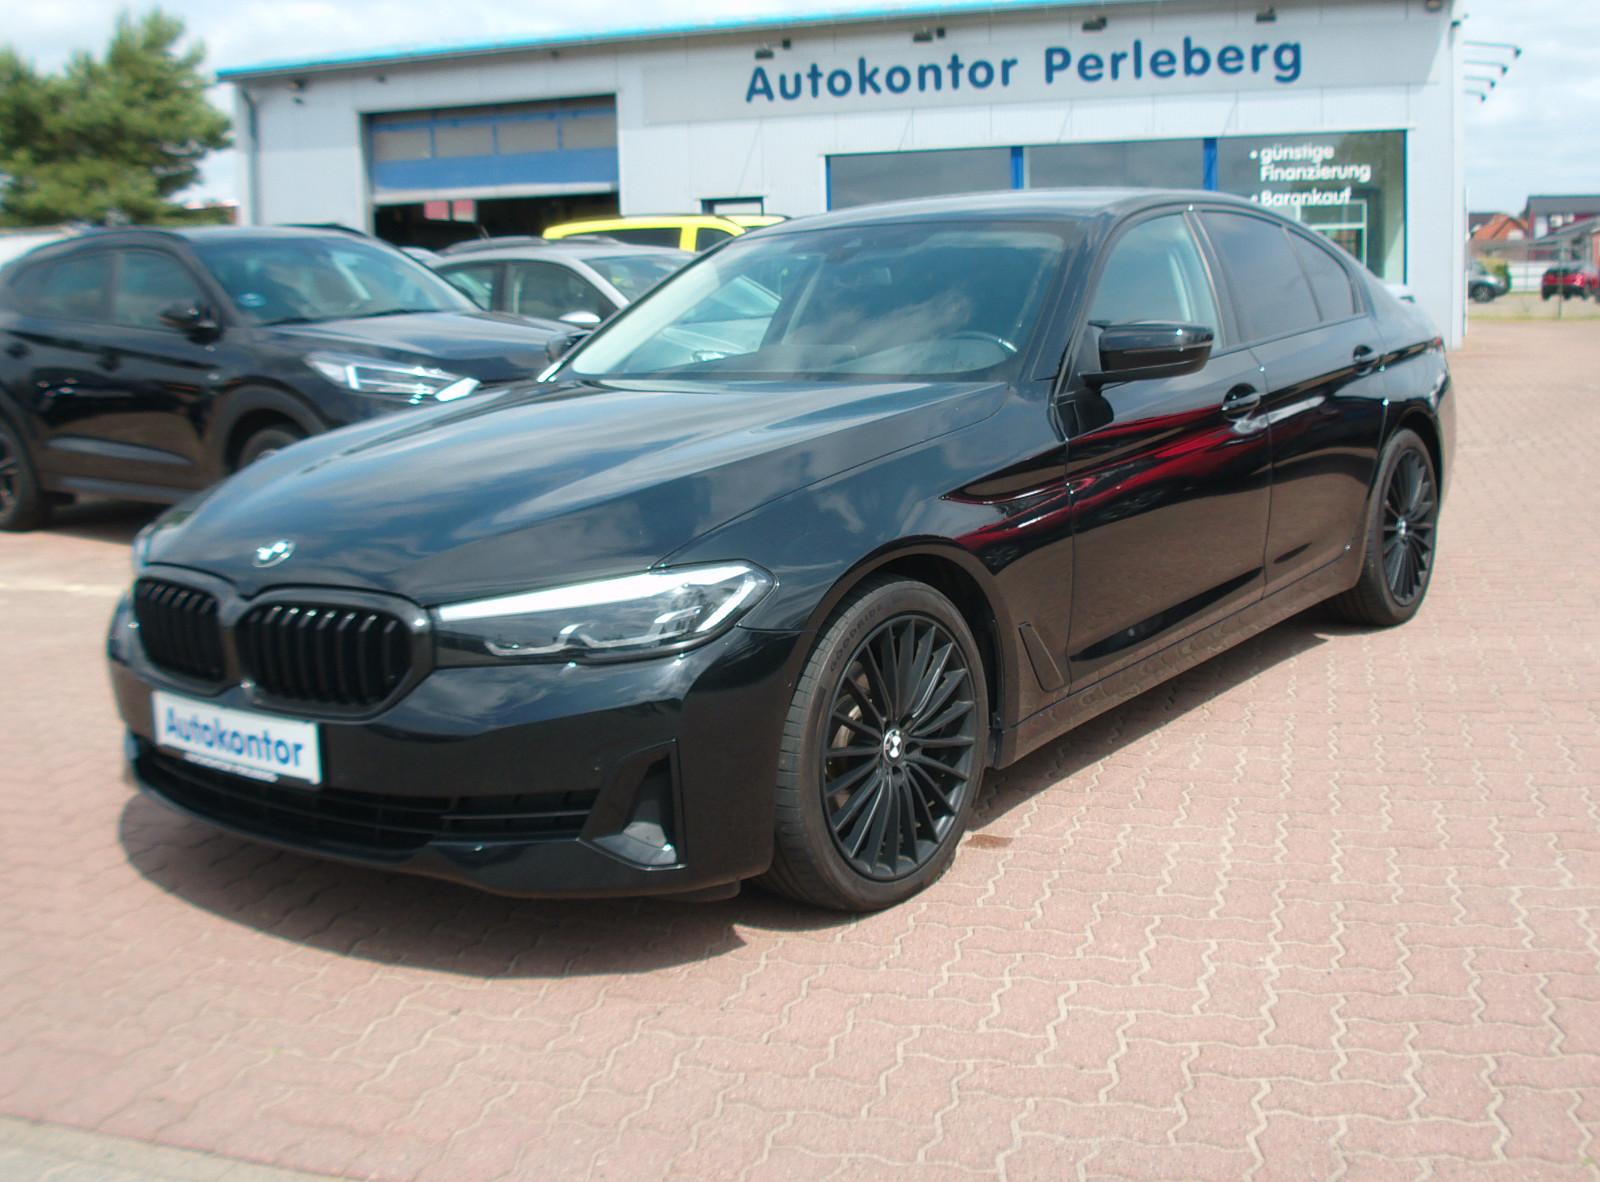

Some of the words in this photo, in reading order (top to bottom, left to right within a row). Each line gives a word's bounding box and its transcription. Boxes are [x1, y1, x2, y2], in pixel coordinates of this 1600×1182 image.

[746, 53, 1018, 103] Autokontor
[1044, 36, 1302, 84] Perleberg
[1260, 143, 1335, 165] günstige
[1260, 163, 1372, 183] Finanzierung
[1260, 187, 1352, 206] Barankauf
[166, 707, 304, 767] Autokontor
